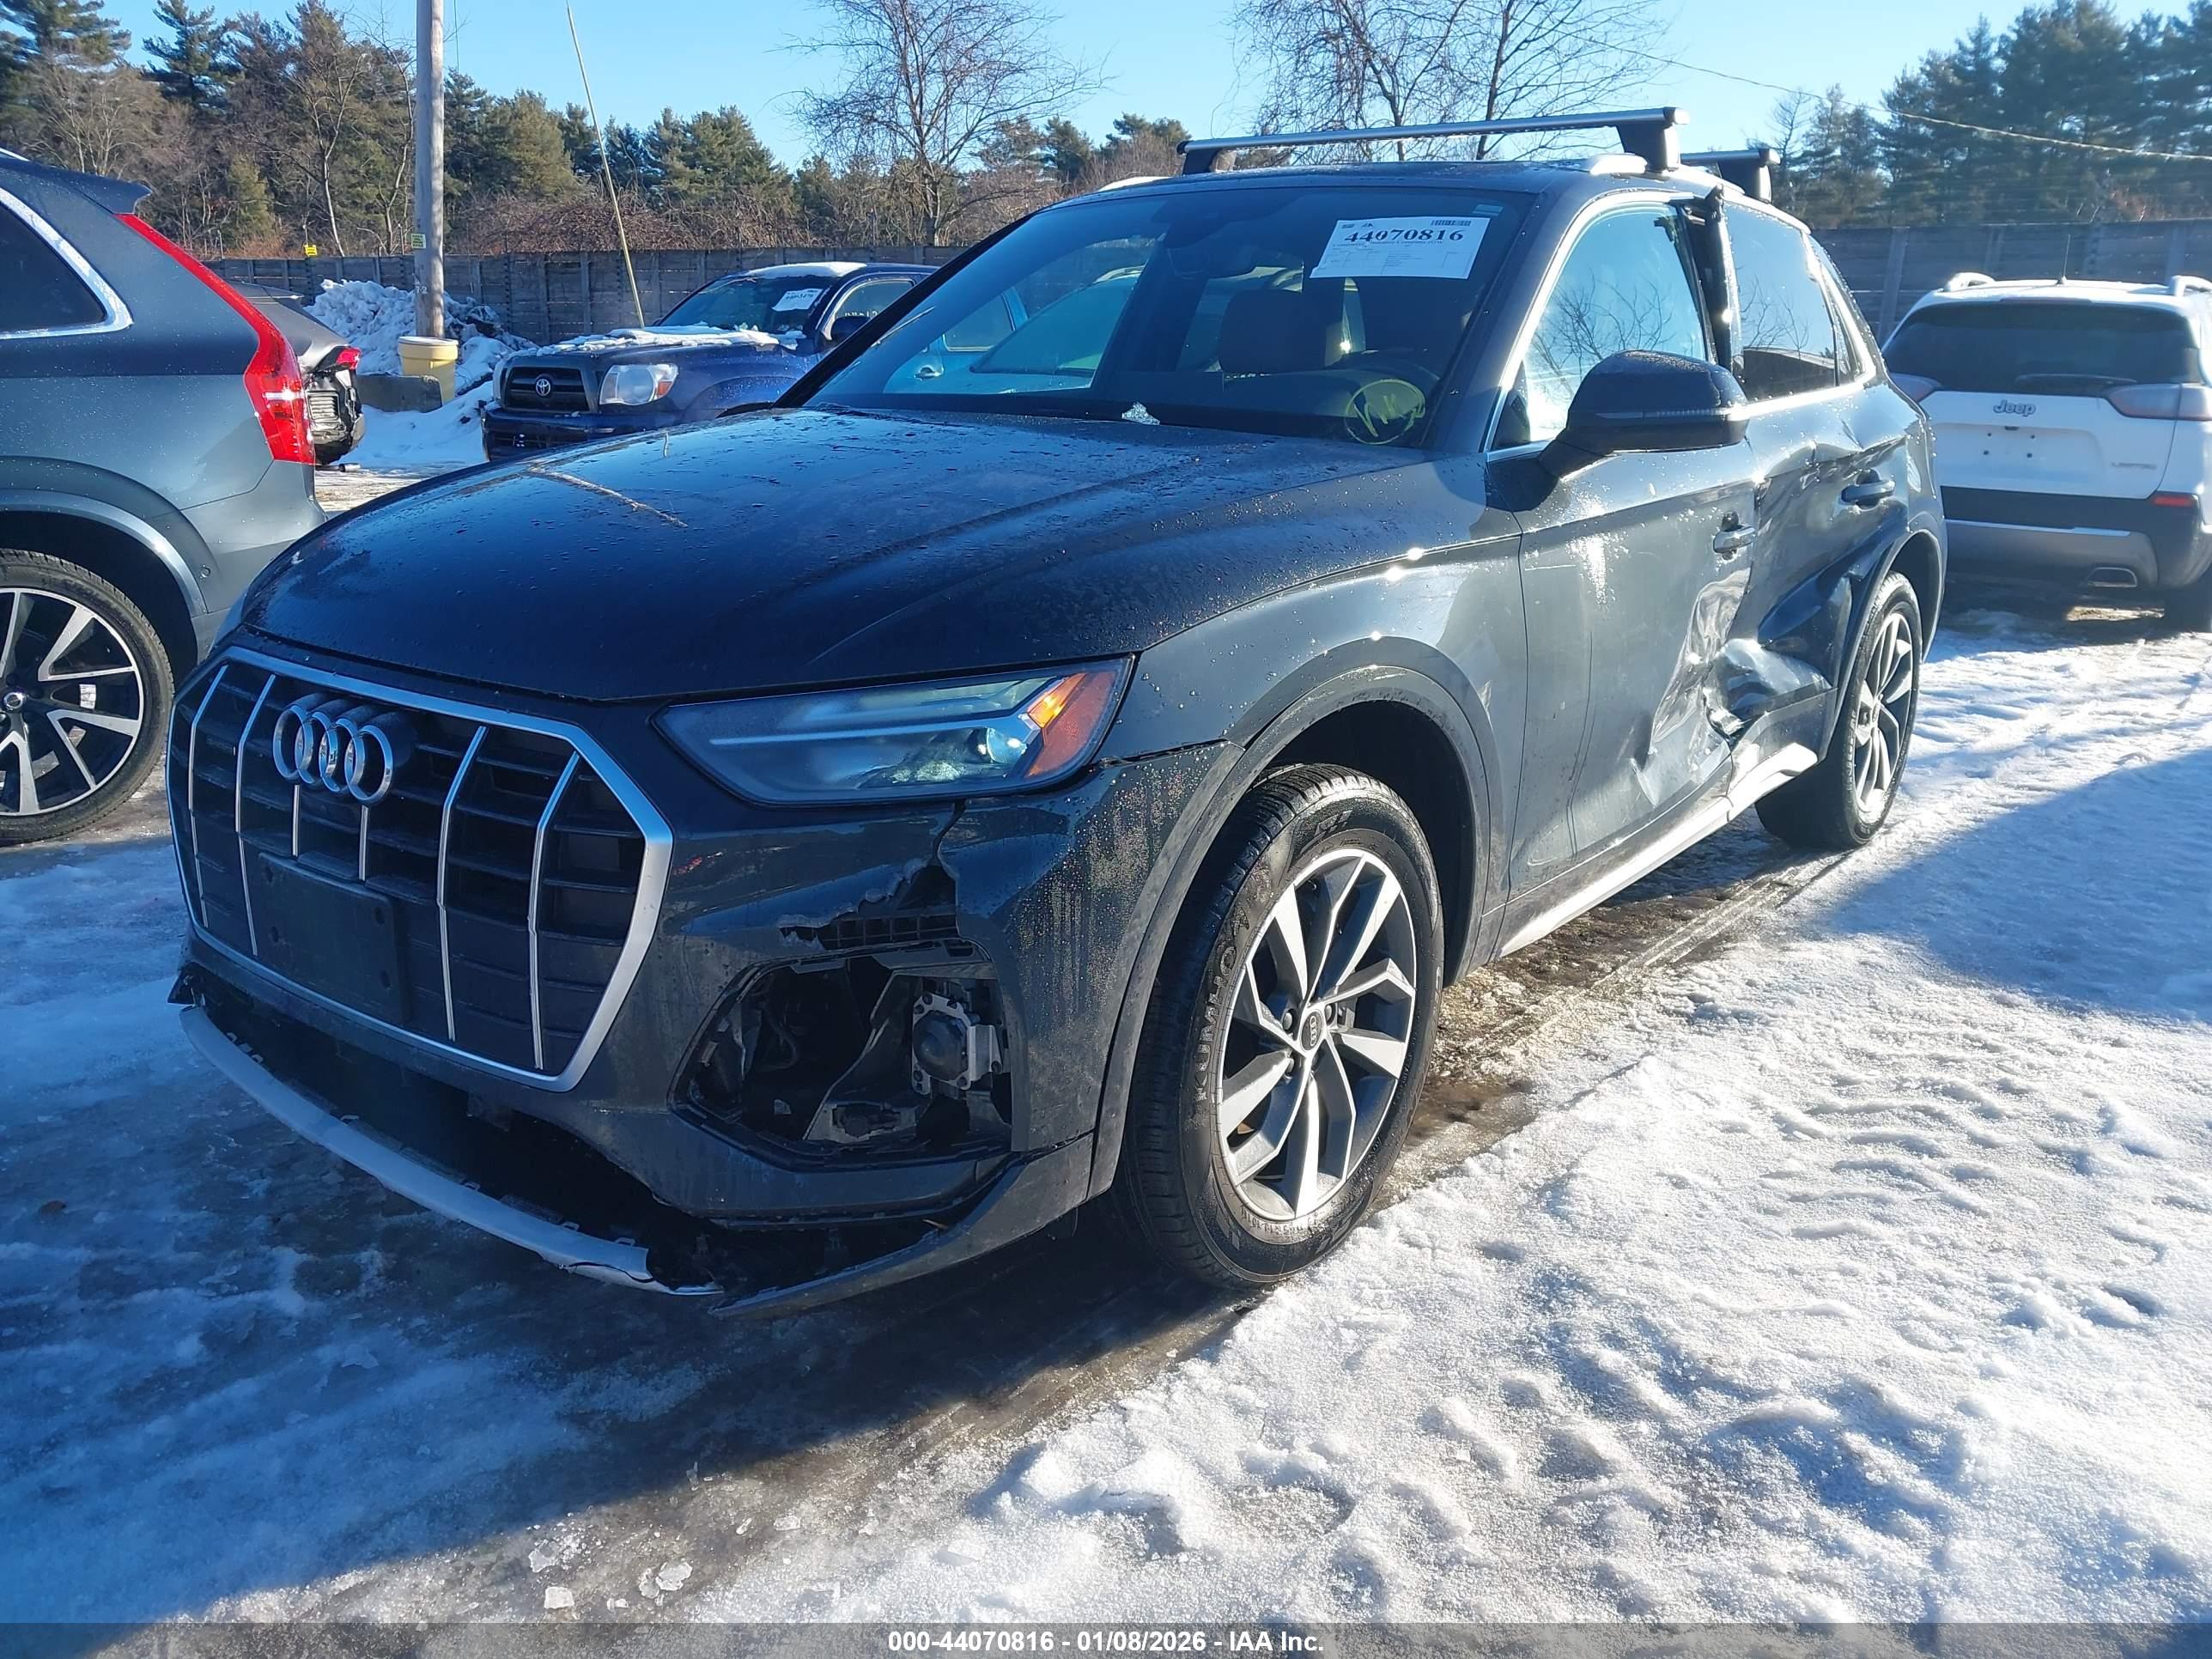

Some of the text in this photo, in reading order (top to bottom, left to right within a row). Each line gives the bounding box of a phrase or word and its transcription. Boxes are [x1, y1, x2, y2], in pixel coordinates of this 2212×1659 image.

[1345, 229, 1464, 242] 44070816
[1993, 399, 2036, 417] Jeep
[1195, 945, 1237, 1101] KUMHO
